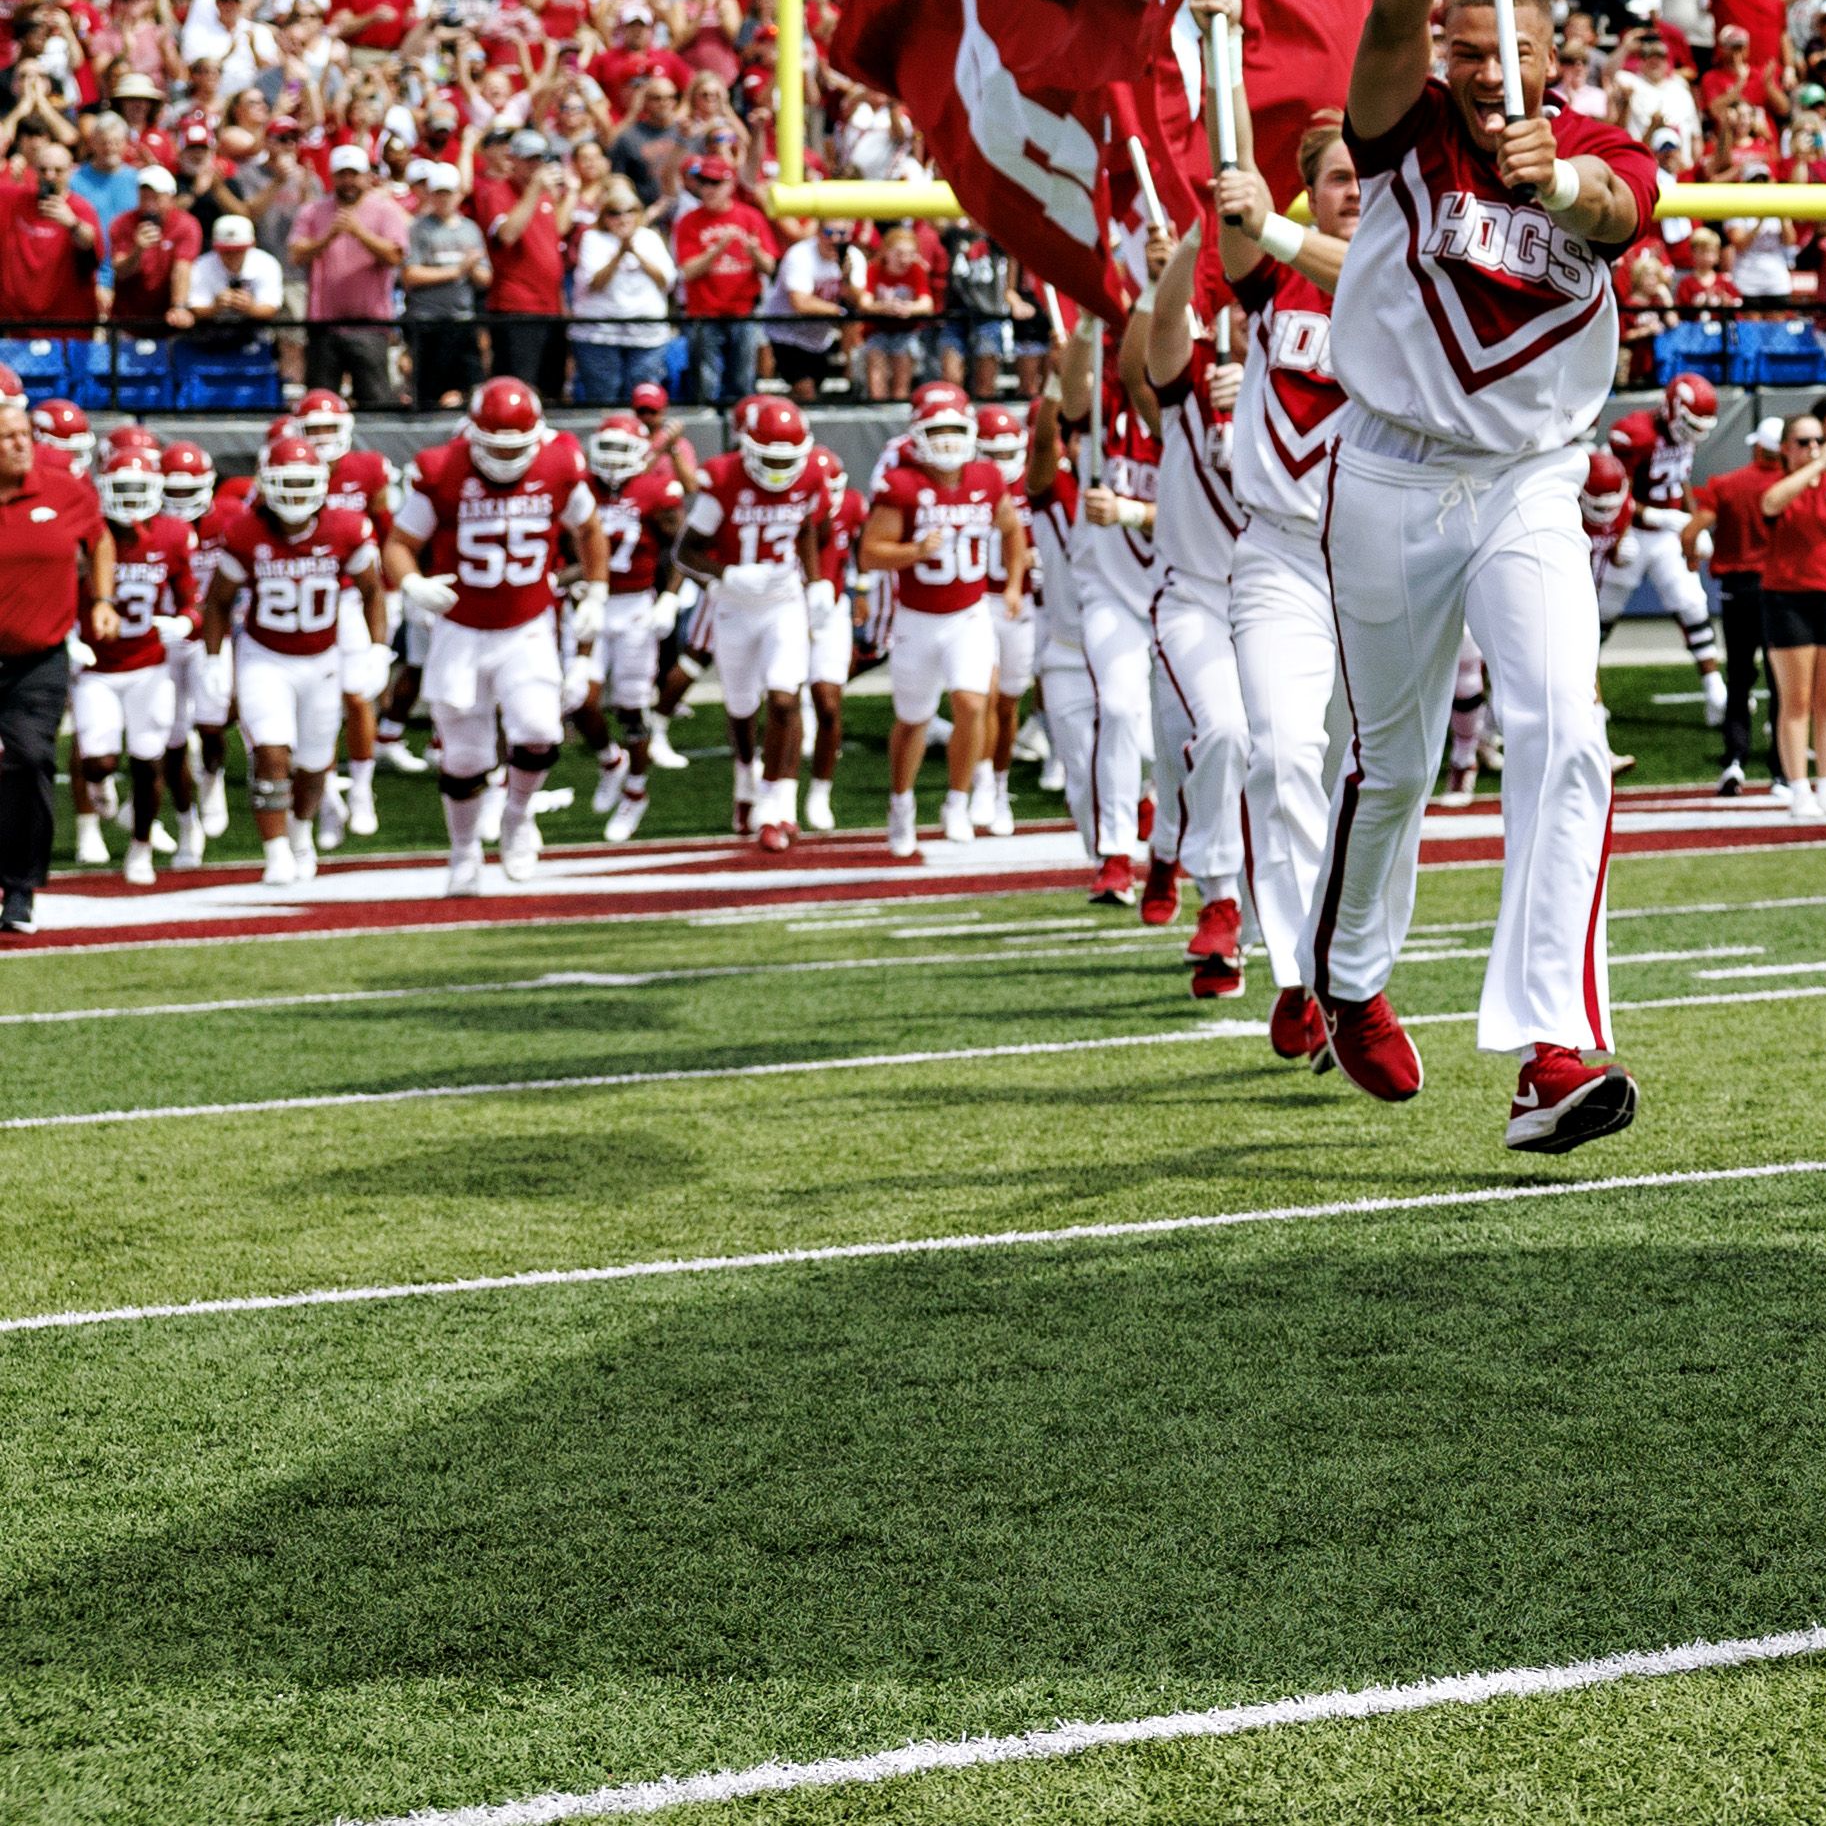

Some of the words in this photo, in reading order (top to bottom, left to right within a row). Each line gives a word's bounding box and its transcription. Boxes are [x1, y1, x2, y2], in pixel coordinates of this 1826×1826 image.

[1421, 190, 1597, 302] HOGS
[457, 518, 552, 588] 55
[913, 526, 989, 586] 30
[255, 576, 341, 634] 20
